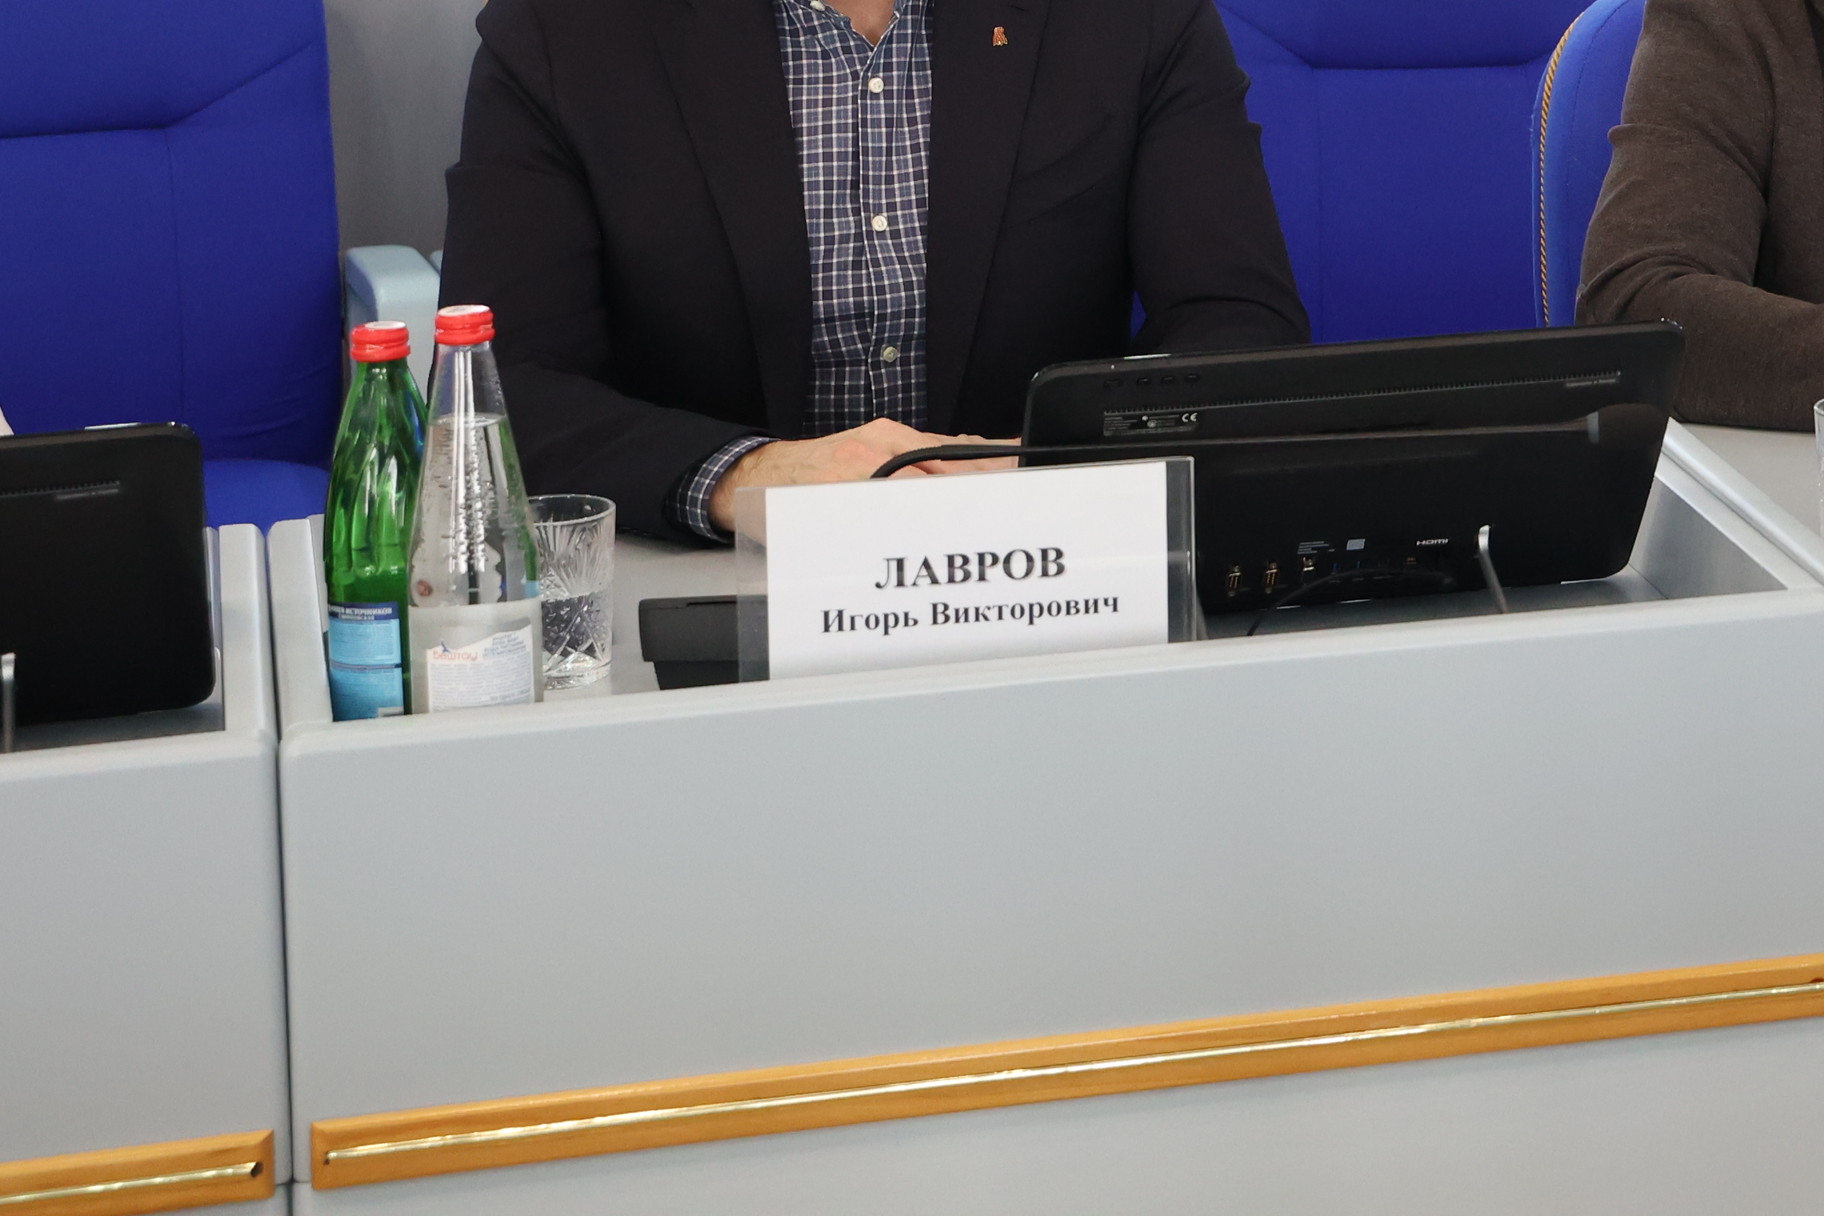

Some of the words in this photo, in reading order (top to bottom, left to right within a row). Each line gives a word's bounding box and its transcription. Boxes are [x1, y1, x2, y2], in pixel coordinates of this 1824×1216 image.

[874, 547, 1066, 590] ЛАВРОВ
[821, 608, 919, 636] Игорь
[930, 596, 1120, 627] Викторович
